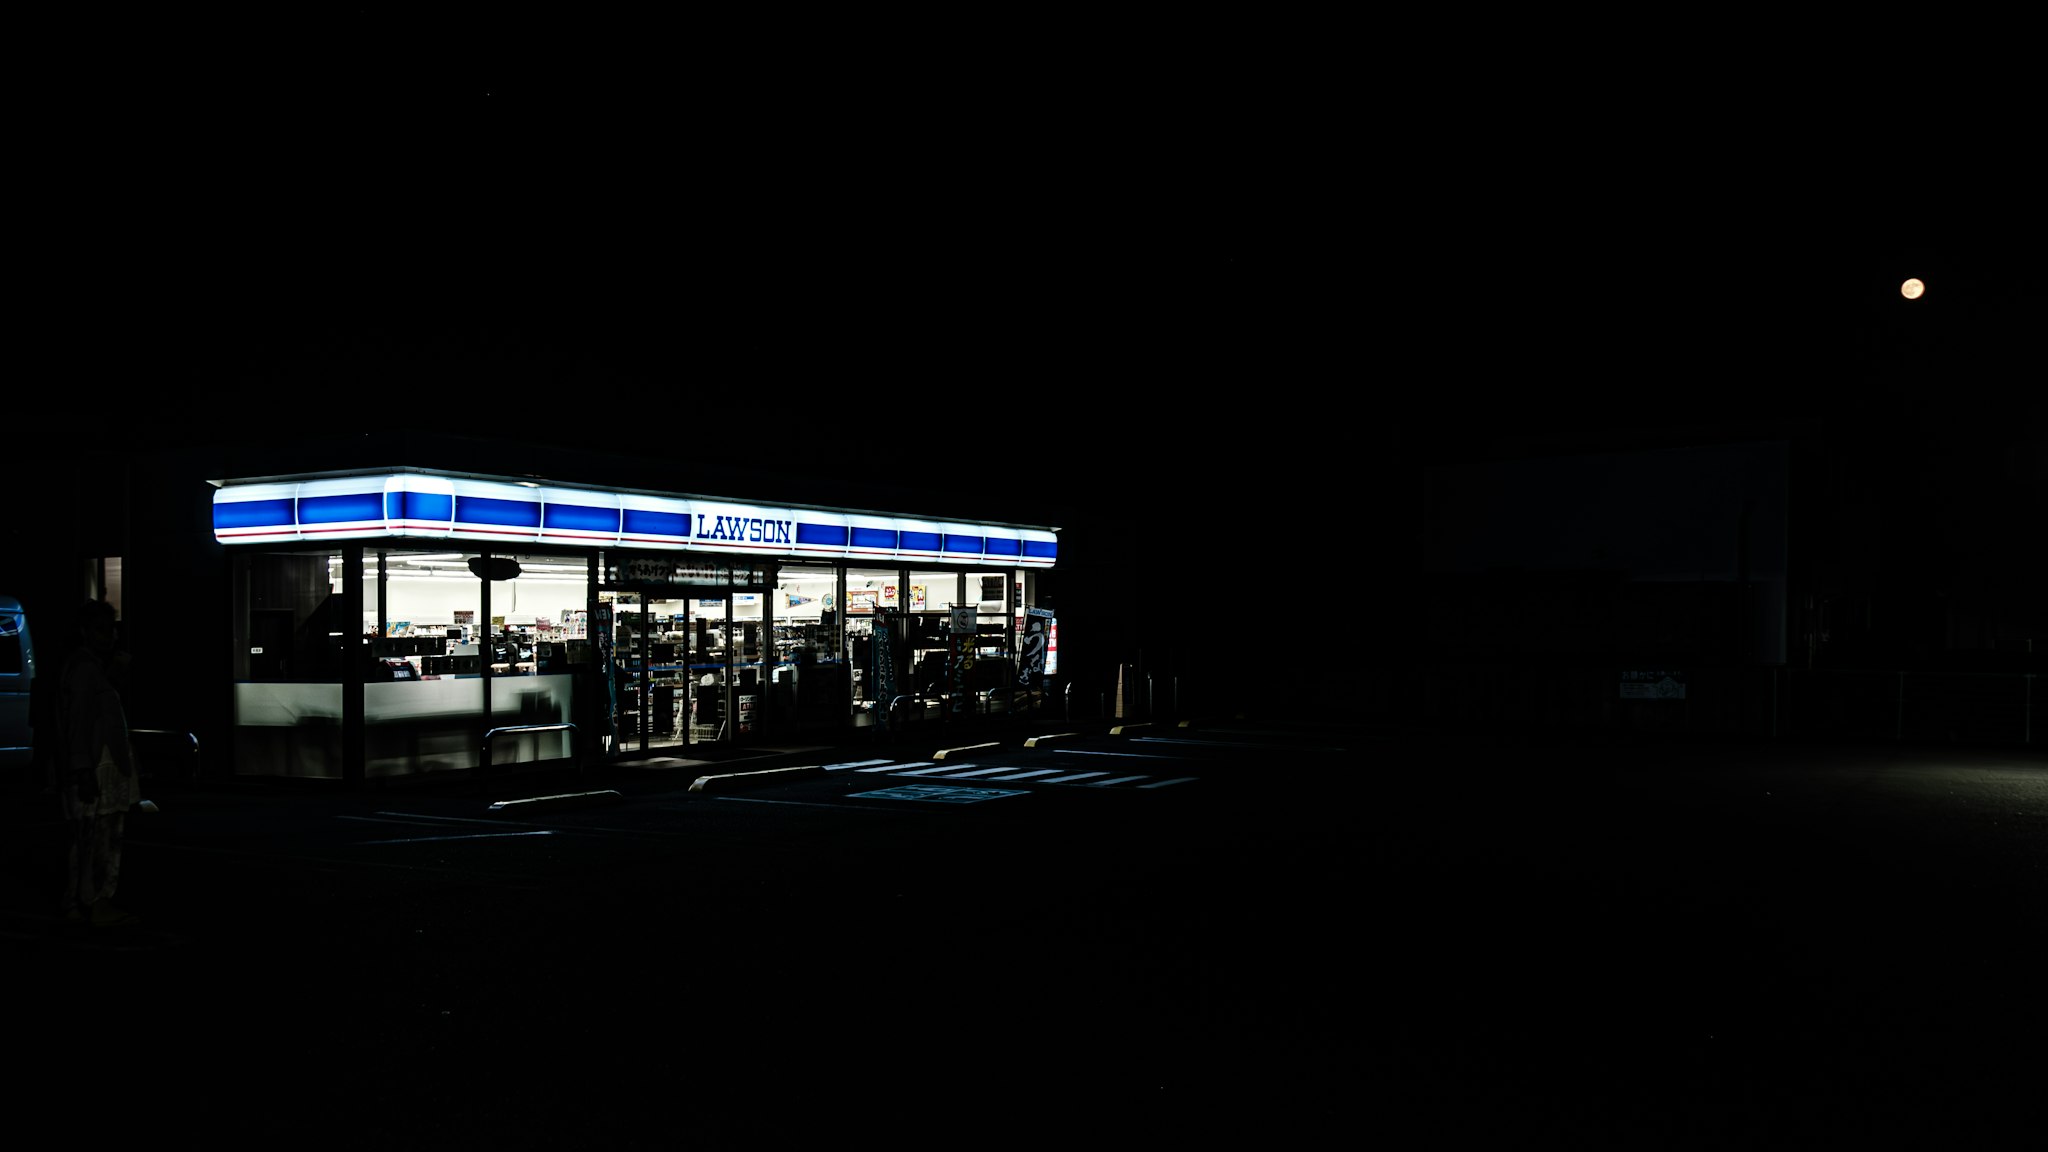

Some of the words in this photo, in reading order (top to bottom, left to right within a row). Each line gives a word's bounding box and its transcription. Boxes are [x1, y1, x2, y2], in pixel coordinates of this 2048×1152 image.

[696, 514, 791, 544] LAWSON
[962, 636, 976, 671] 光る
[1018, 621, 1046, 686] うなぎ
